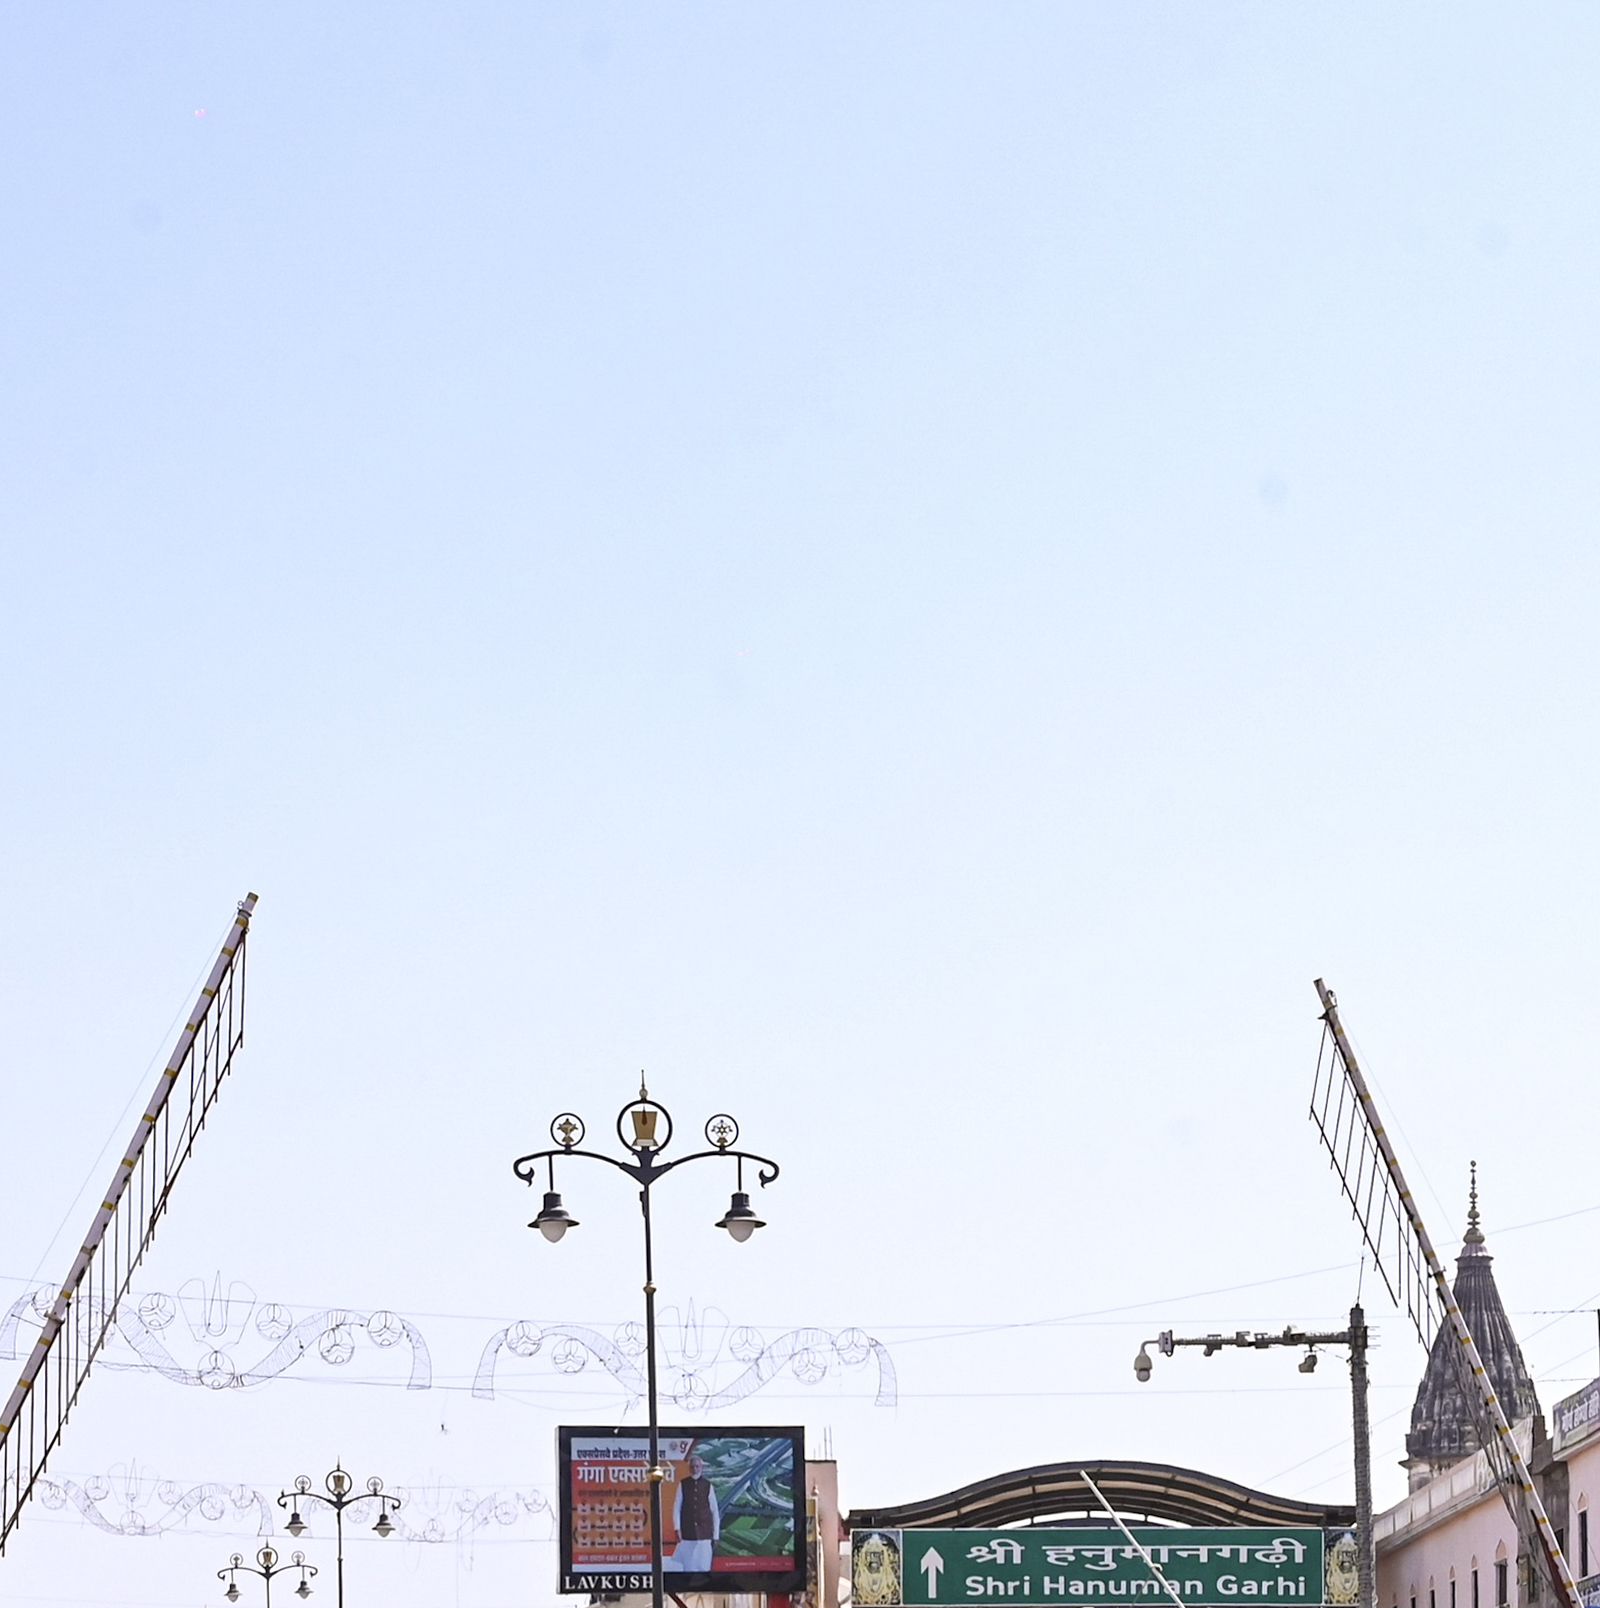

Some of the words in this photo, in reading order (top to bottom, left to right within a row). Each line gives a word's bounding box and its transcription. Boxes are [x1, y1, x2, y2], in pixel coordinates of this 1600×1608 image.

[577, 1462, 605, 1483] गंगा
[608, 1461, 676, 1484] एक्सप्रेवे
[965, 1538, 1025, 1564] श्री
[1041, 1537, 1307, 1570] हनुमानगढ़ी
[565, 1575, 653, 1590] LAVKUSH
[965, 1575, 1031, 1596] Shri
[1043, 1576, 1203, 1596] Hanuman
[1216, 1575, 1306, 1596] Garhi
